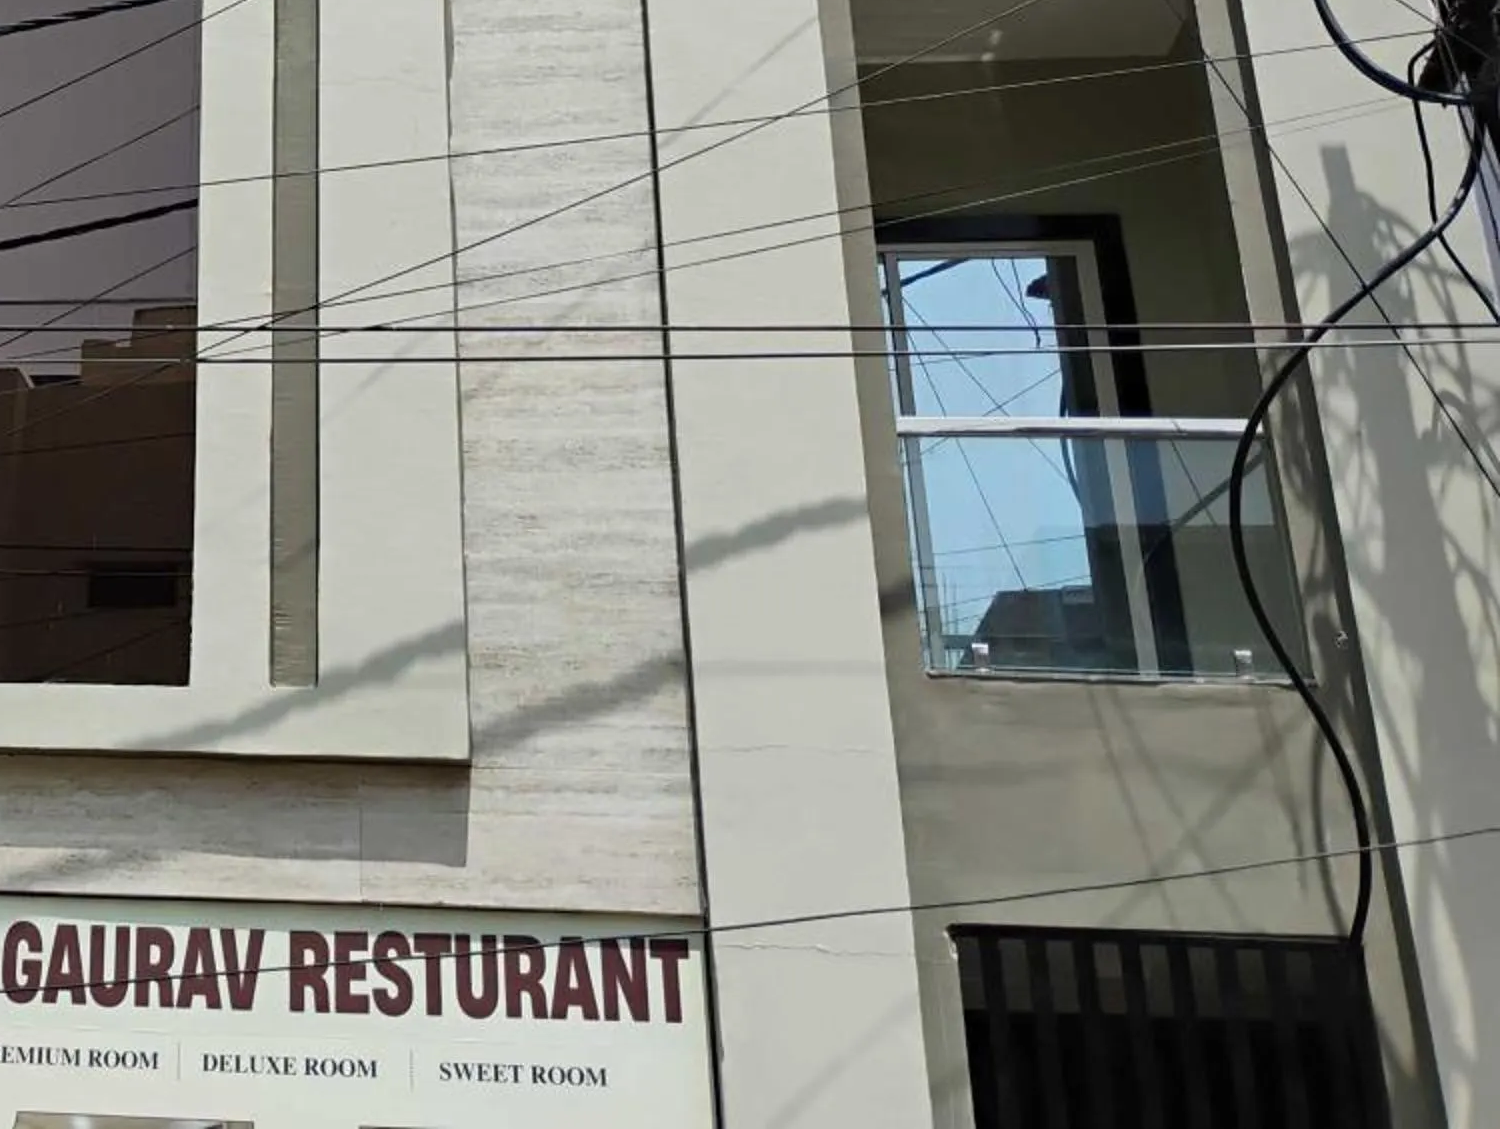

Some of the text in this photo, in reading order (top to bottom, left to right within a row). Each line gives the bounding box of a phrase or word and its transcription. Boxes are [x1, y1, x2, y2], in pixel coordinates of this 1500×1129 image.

[1, 920, 266, 1011] GAURAV
[288, 930, 690, 1023] RESTURANT
[86, 1049, 160, 1071] ROOM
[201, 1052, 379, 1079] DELUXE ROOM
[438, 1061, 609, 1087] SWEET ROOM
